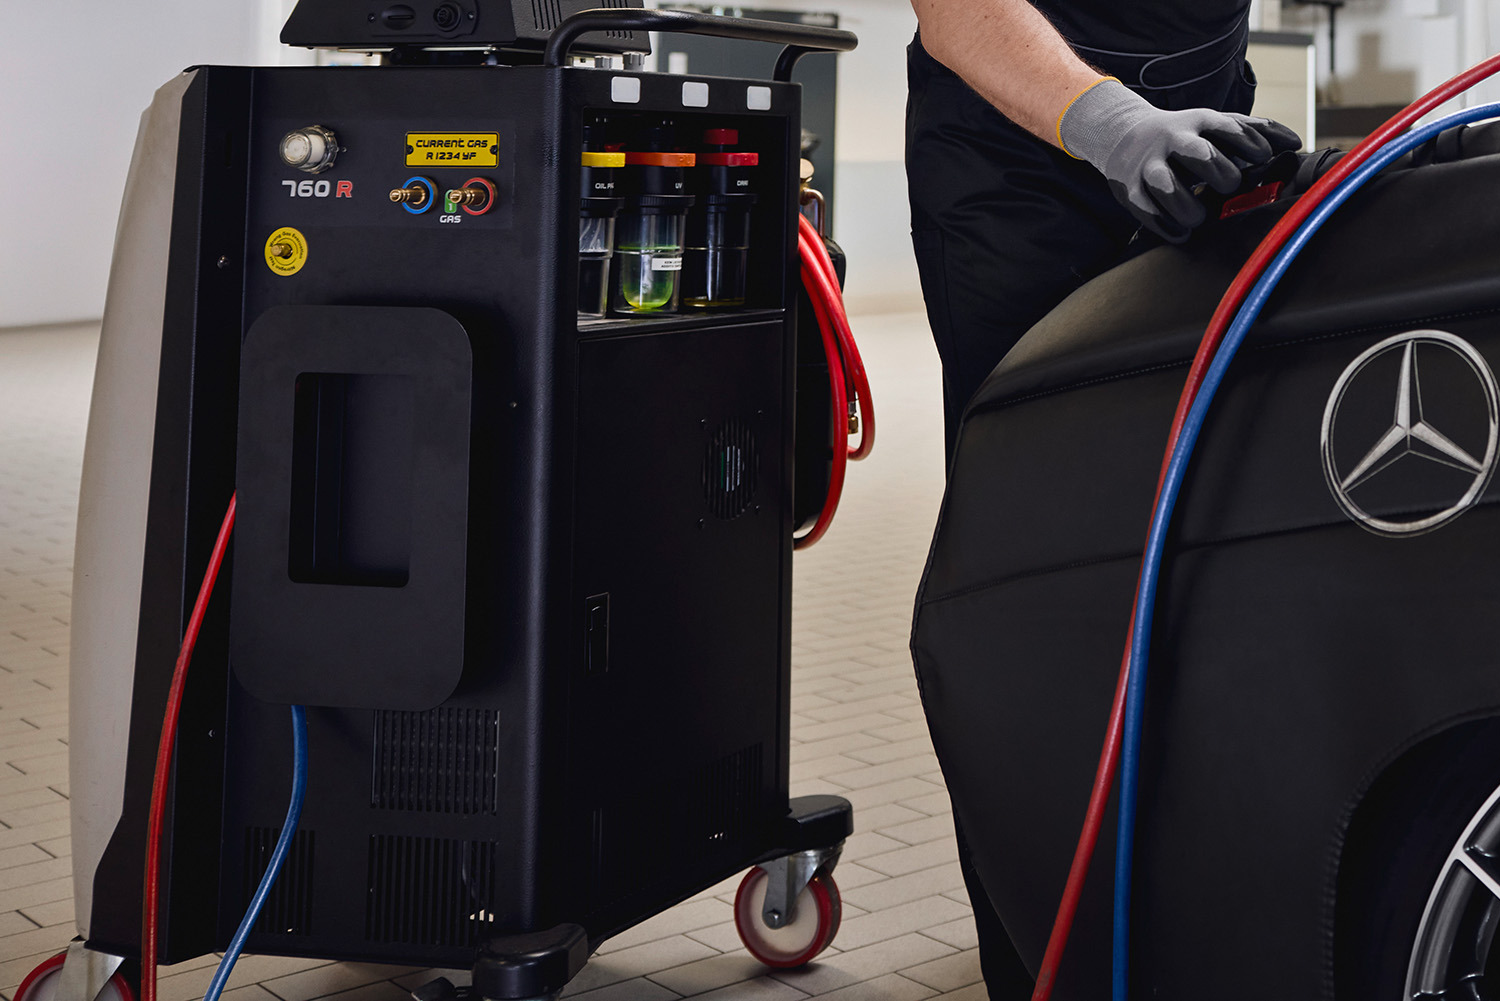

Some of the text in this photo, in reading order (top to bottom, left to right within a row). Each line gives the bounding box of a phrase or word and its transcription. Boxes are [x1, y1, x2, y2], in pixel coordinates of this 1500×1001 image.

[467, 139, 488, 148] GAS
[426, 152, 477, 160] R 1234 YF
[281, 180, 354, 198] 760 R
[439, 215, 462, 224] GAS
